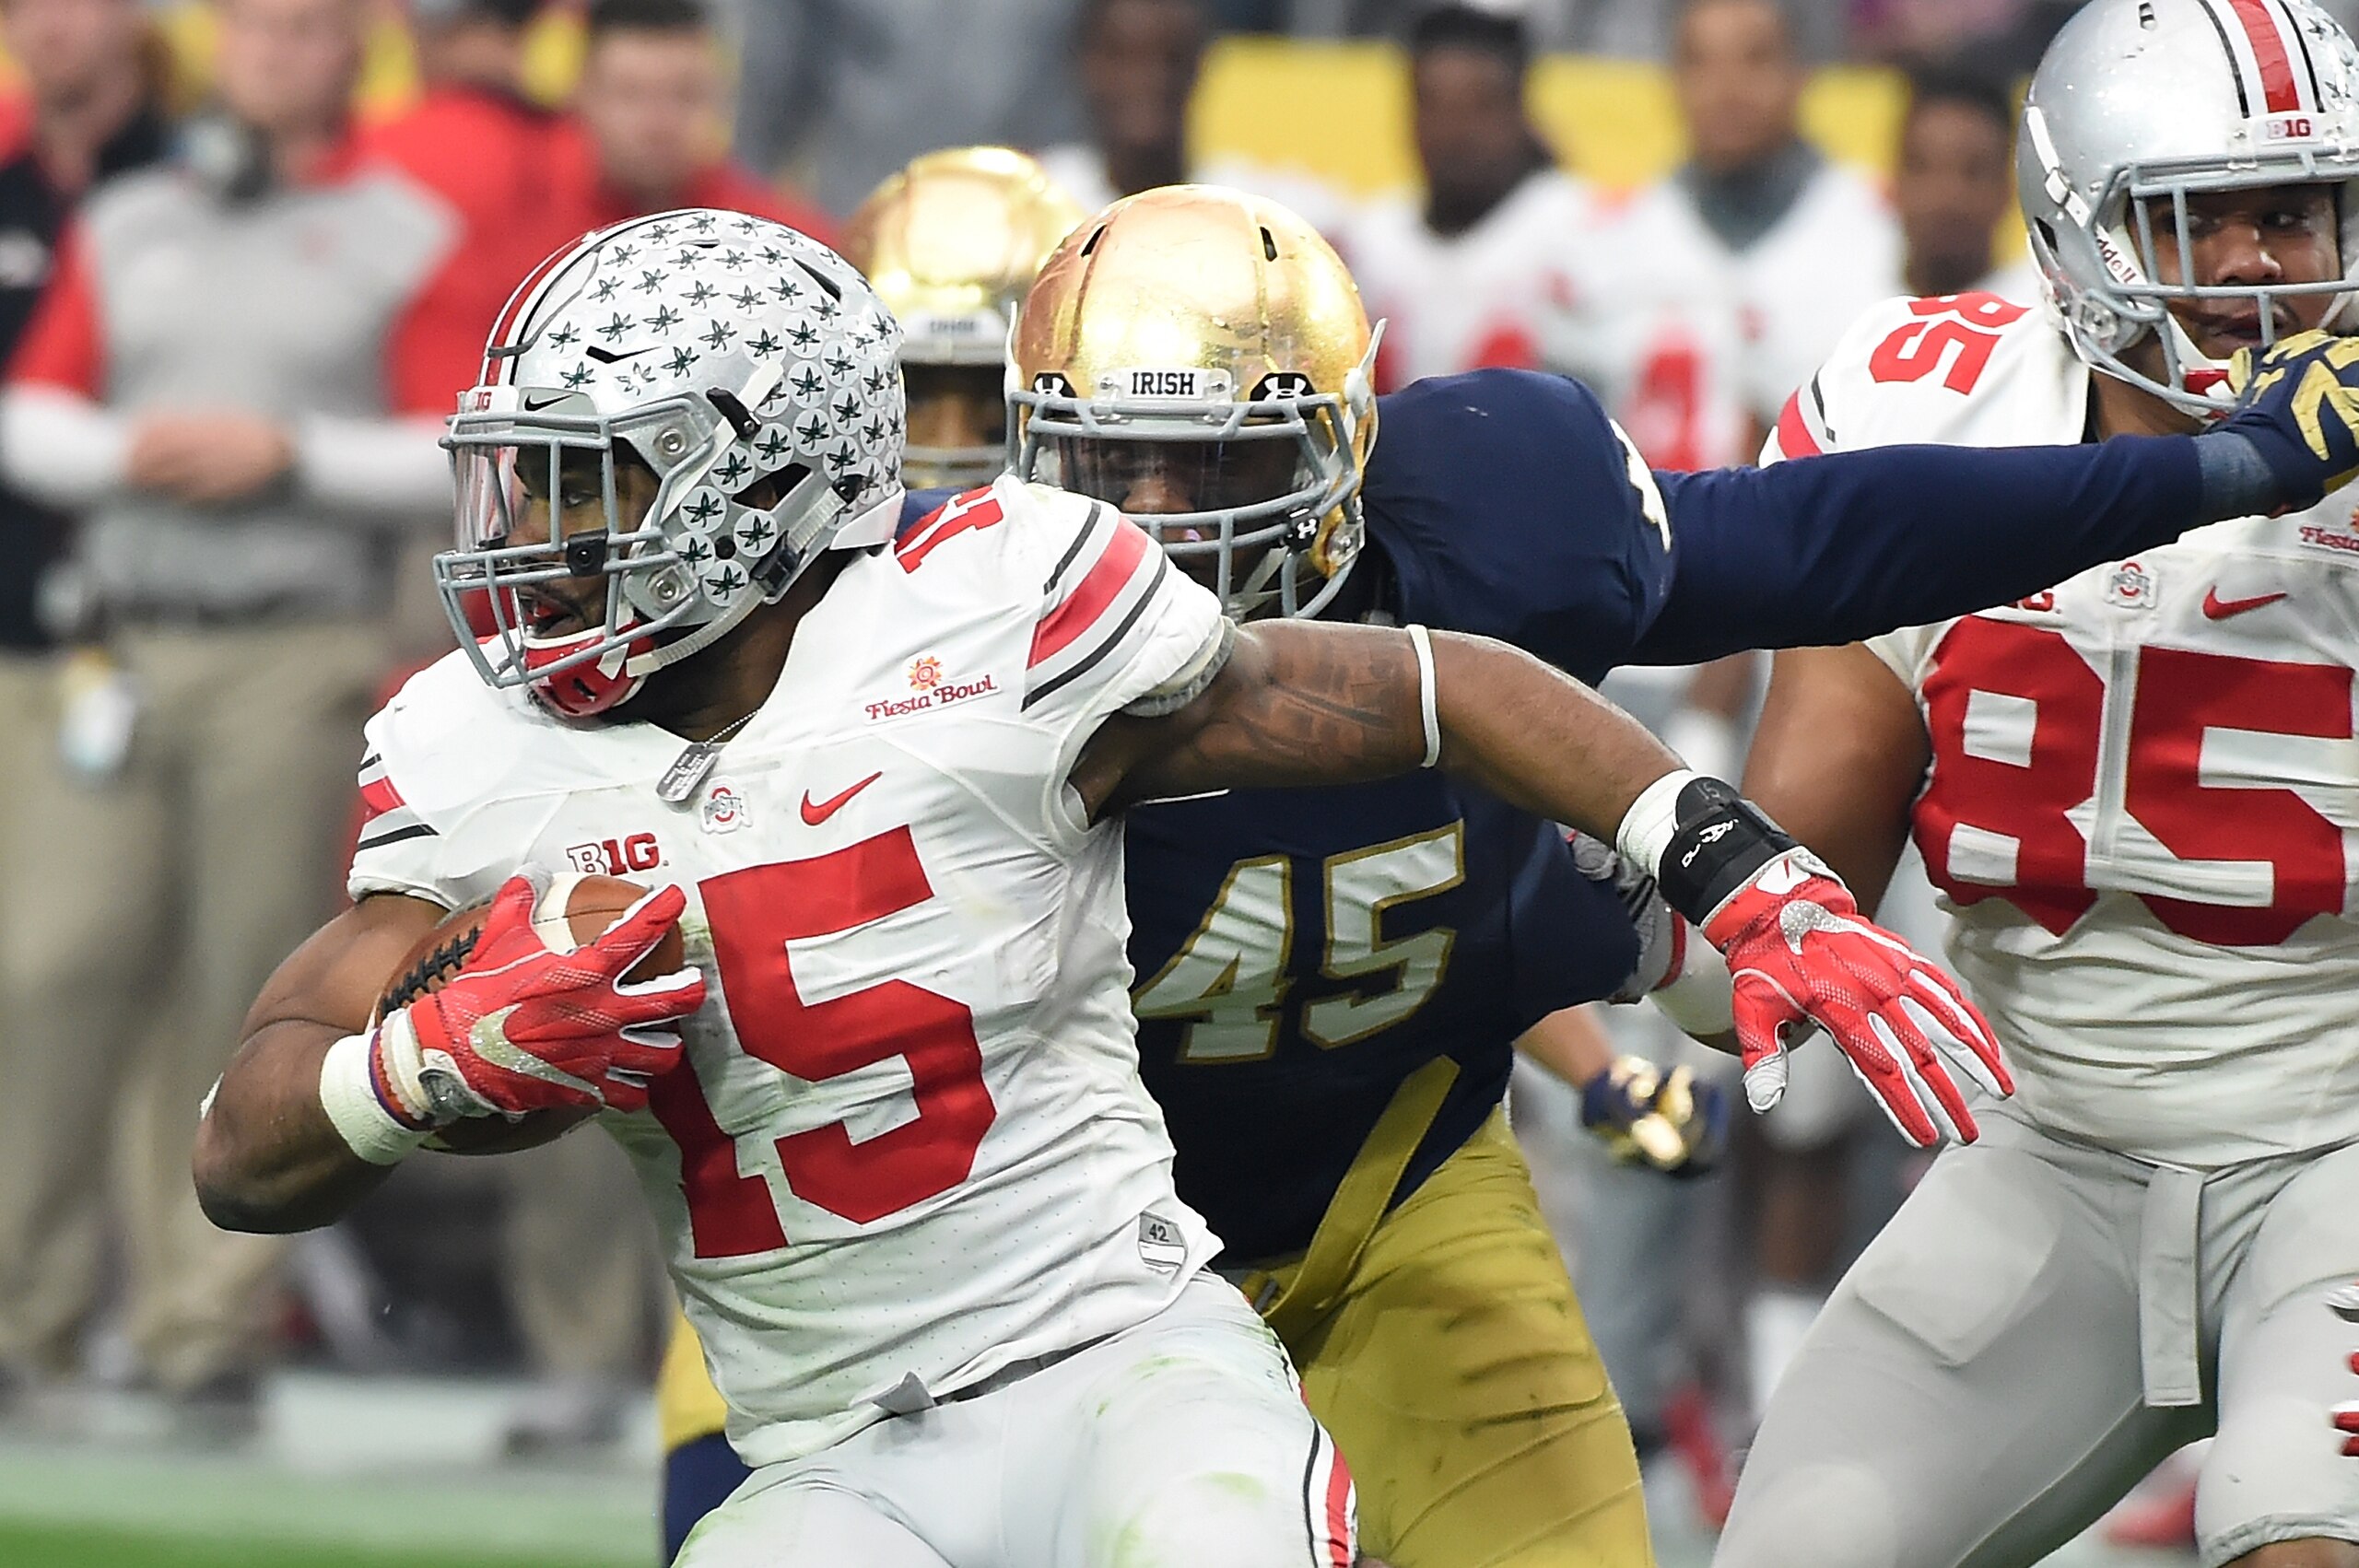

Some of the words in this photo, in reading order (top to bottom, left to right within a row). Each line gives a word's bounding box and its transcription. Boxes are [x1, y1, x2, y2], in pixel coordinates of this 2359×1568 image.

[1132, 371, 1195, 395] IRISH
[865, 699, 933, 720] Fiesta
[933, 673, 999, 705] Bowl
[1911, 614, 2356, 947] 85
[1131, 819, 1466, 1065] 45
[1148, 1223, 1170, 1243] 42
